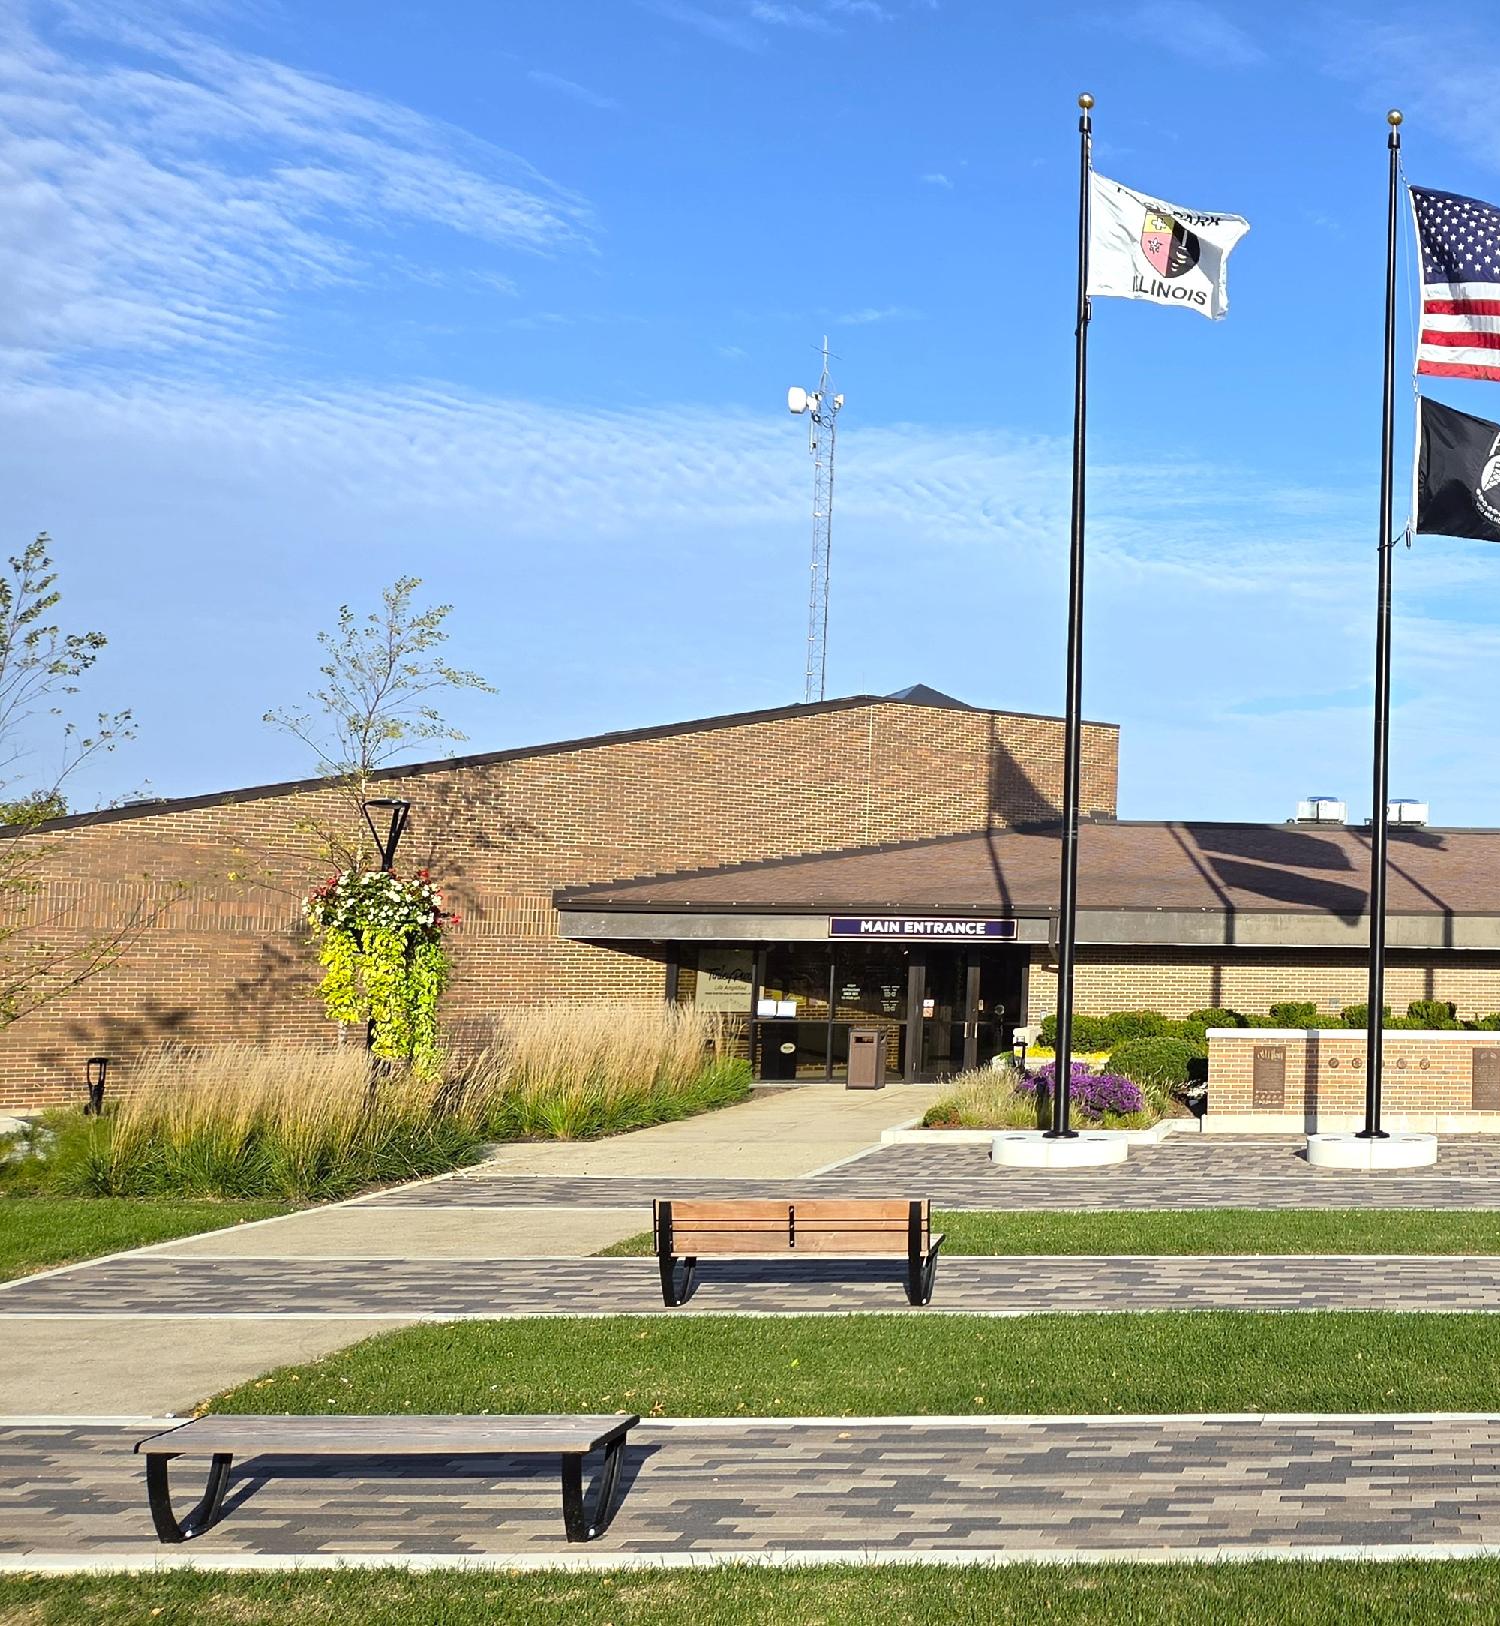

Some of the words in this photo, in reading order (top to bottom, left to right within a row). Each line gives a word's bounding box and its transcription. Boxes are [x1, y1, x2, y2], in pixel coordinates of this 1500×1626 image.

[1132, 274, 1208, 306] ILINOIS
[860, 920, 900, 934] MAIN
[903, 921, 986, 935] ENTRANCE
